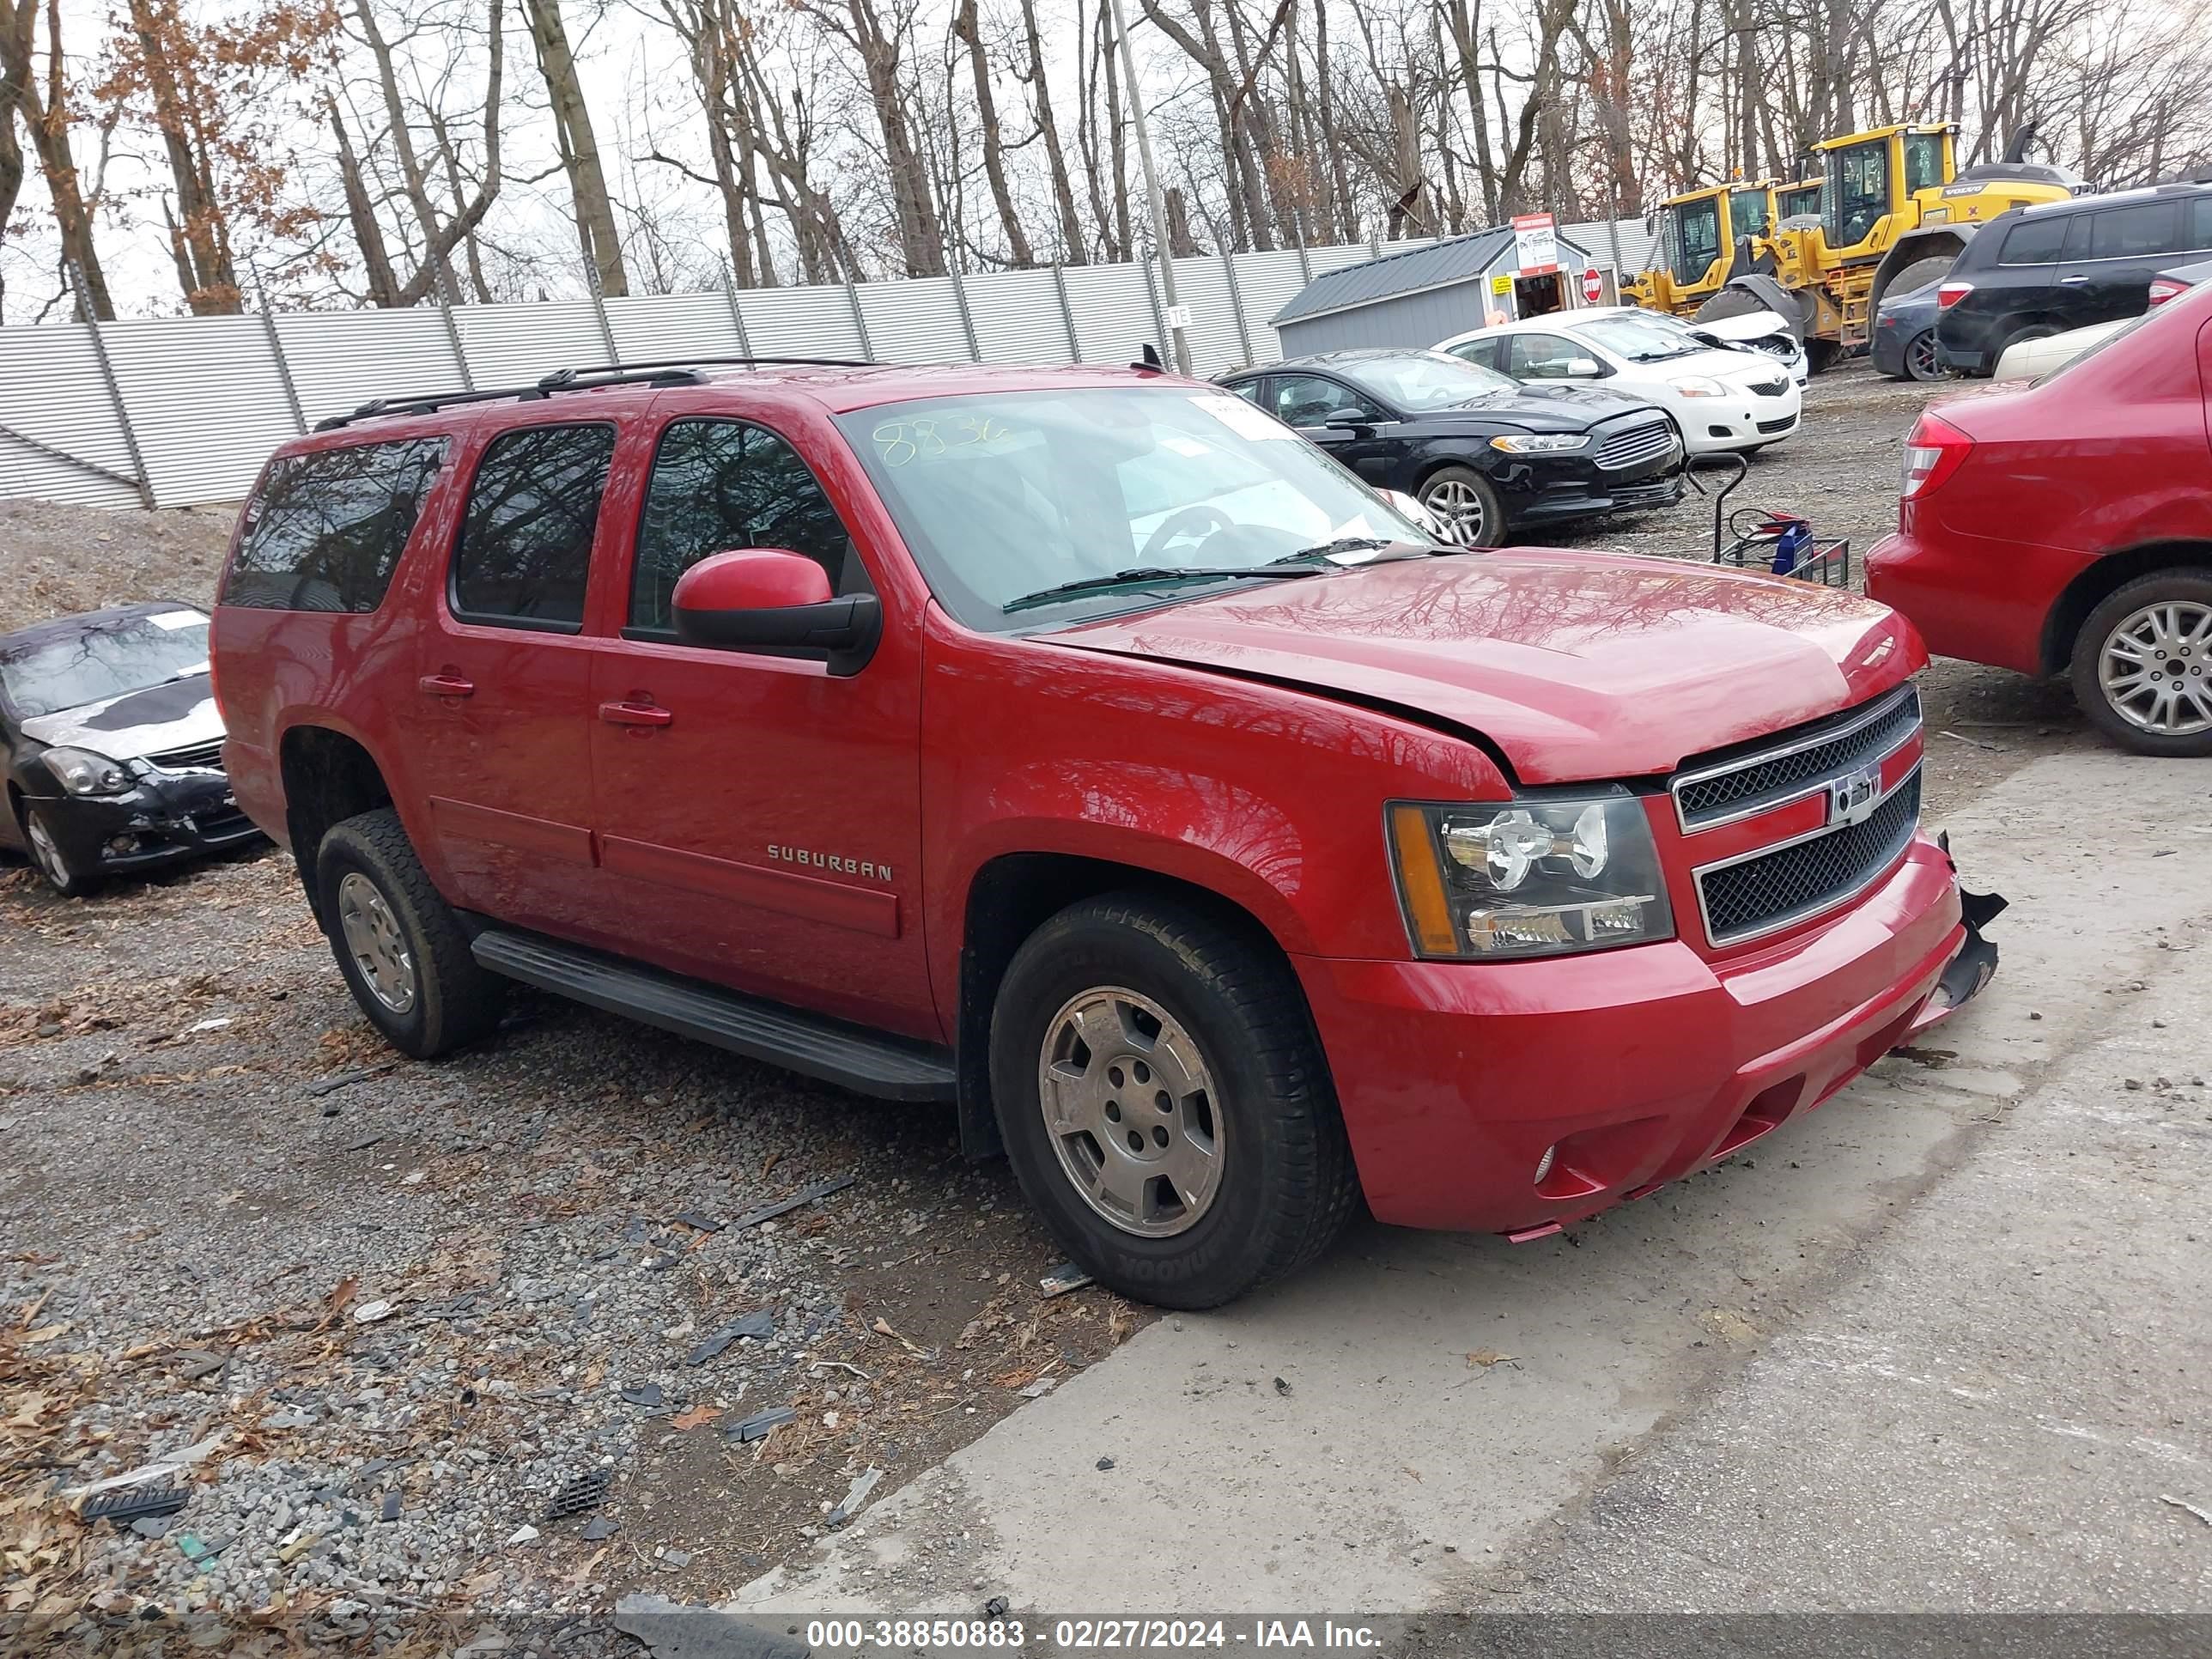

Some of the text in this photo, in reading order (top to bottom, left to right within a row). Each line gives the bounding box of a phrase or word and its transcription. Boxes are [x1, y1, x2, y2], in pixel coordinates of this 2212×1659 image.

[1945, 185, 1983, 196] VOLVO
[1583, 277, 1601, 293] STOP
[768, 844, 892, 881] SUBURBAN
